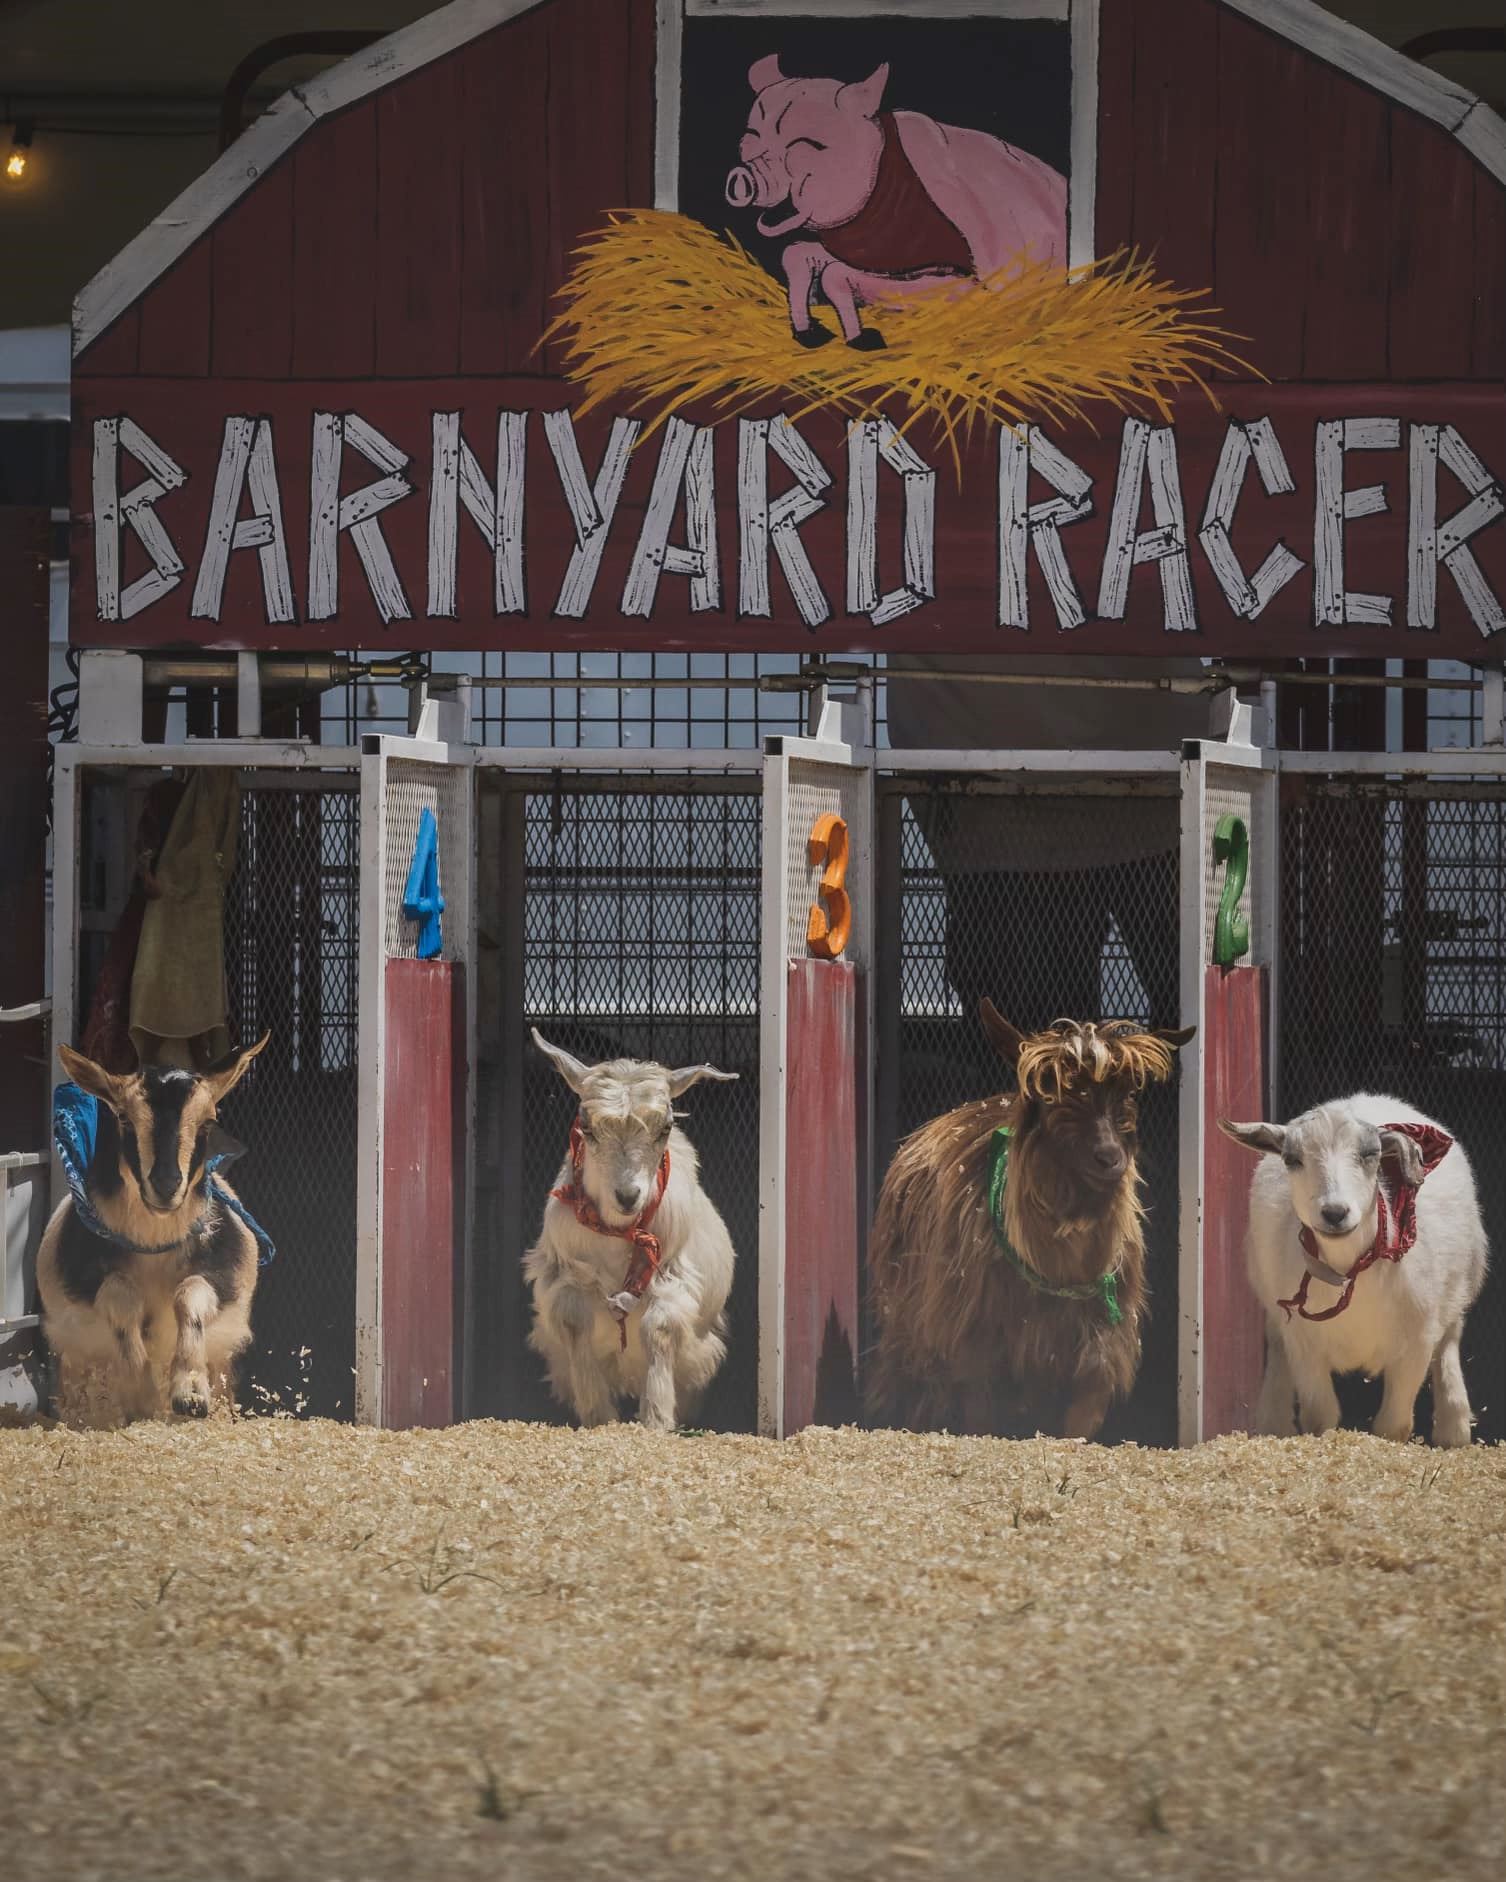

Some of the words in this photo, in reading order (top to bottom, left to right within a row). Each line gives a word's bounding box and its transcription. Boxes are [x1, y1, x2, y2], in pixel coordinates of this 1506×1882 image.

[92, 408, 937, 627] BARNYARD
[402, 807, 445, 959] 4
[807, 813, 852, 959] 3
[1207, 815, 1249, 966] 2
